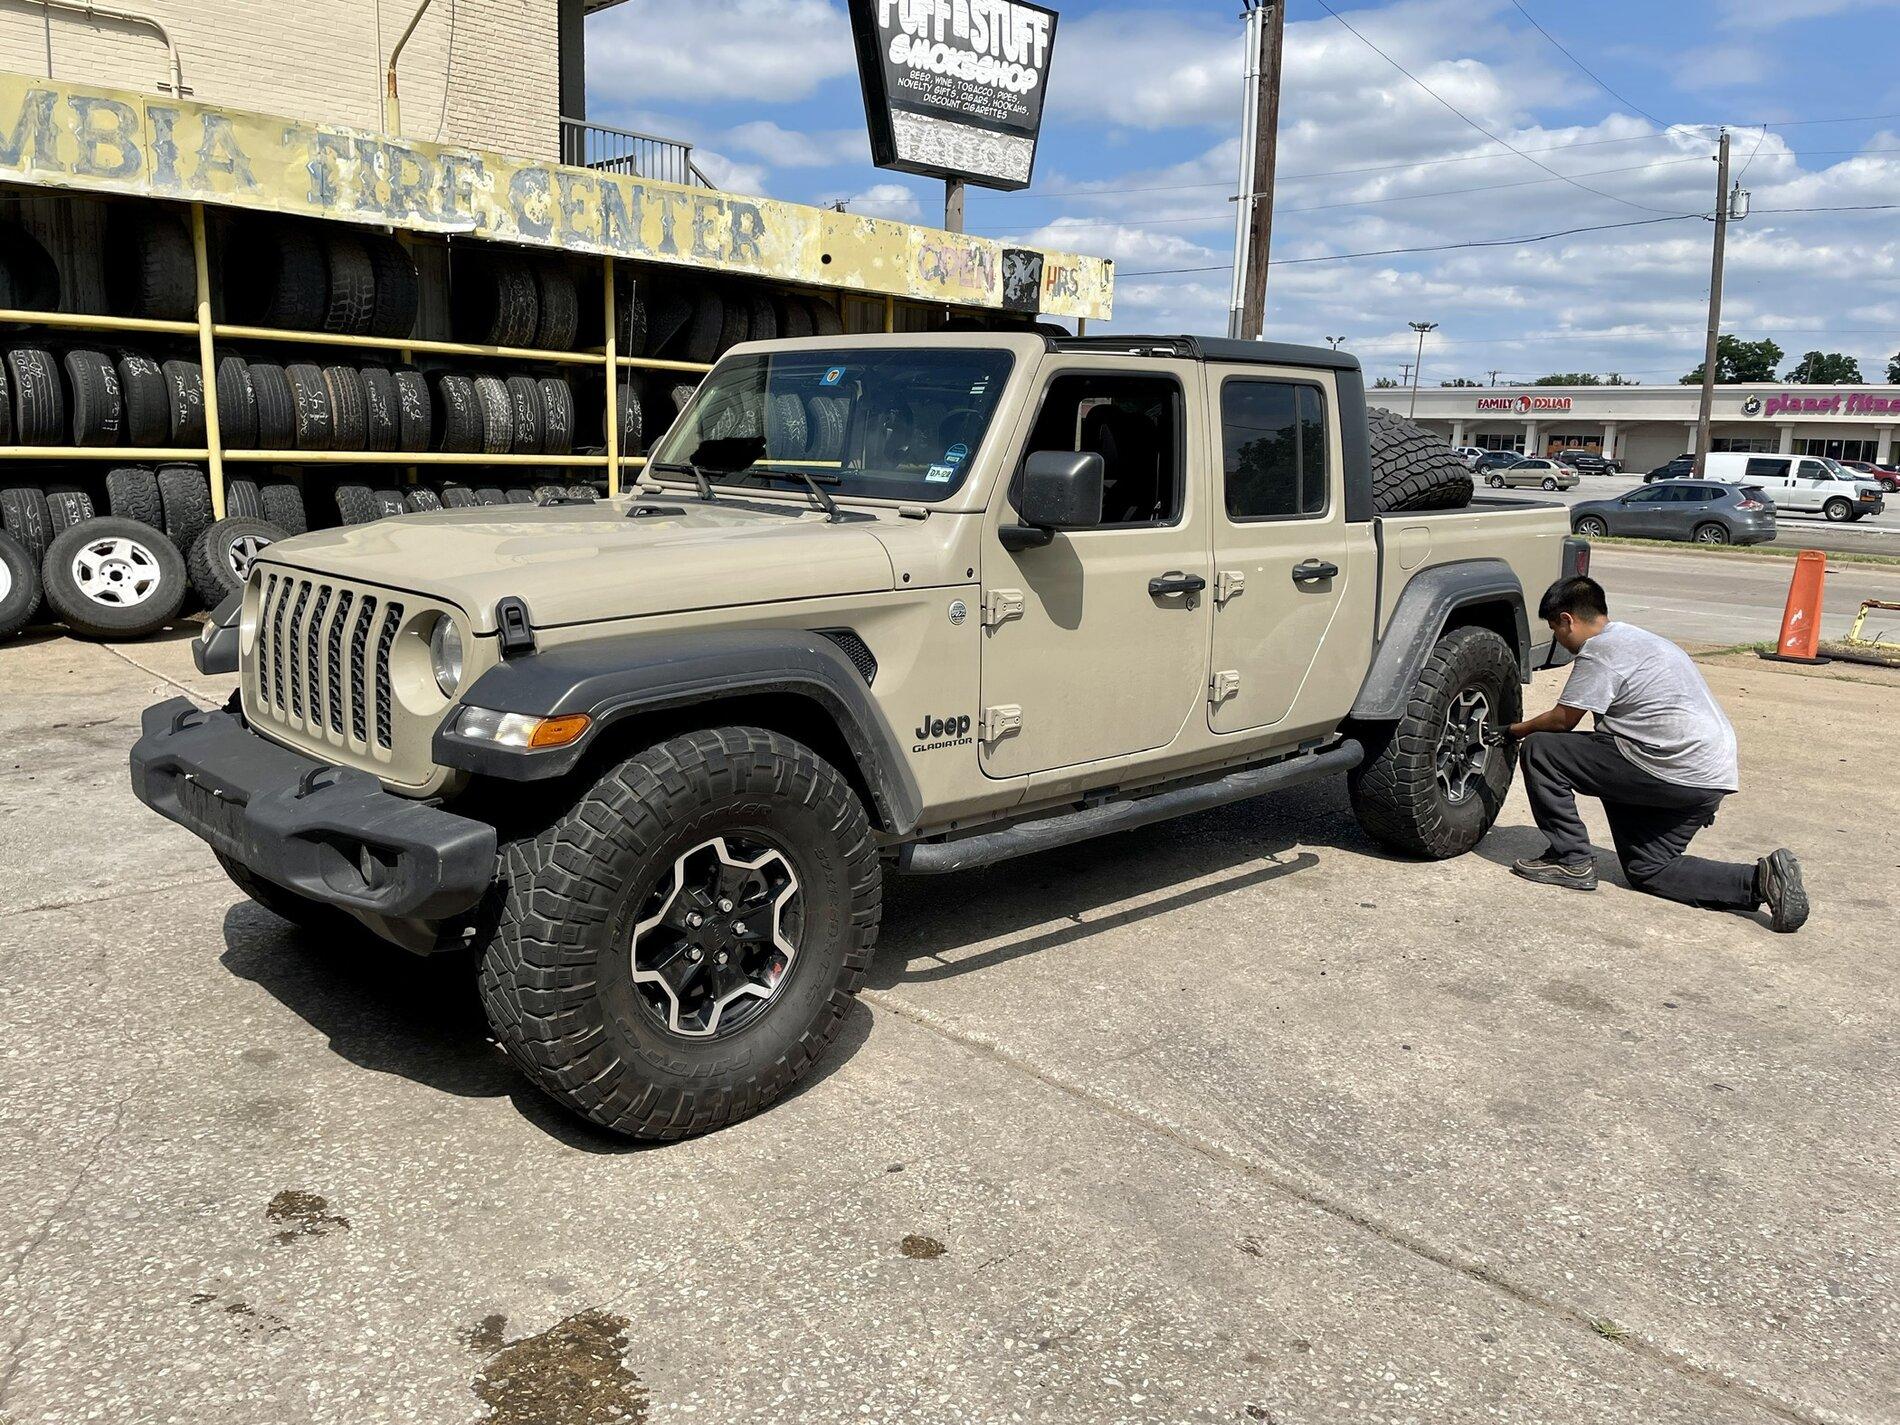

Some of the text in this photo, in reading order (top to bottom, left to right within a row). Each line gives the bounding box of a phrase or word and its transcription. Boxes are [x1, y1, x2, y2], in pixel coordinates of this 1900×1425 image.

[970, 0, 1049, 69] STUFF
[898, 78, 1030, 116] NOVELTY GIFTS, CIGARS, HOOKAHS,
[910, 70, 1020, 105] BEER, WINE, TOBACCO, PIPES,
[924, 93, 1008, 120] DISCOUNT CIGARETTES
[509, 167, 766, 261] CENTER
[918, 244, 995, 293] OPEN
[1046, 265, 1080, 299] HRS
[1477, 397, 1573, 409] FAMILY DOLLAR
[1764, 393, 1841, 416] planet
[915, 713, 971, 741] Jeep
[912, 736, 973, 753] GLADIATOR
